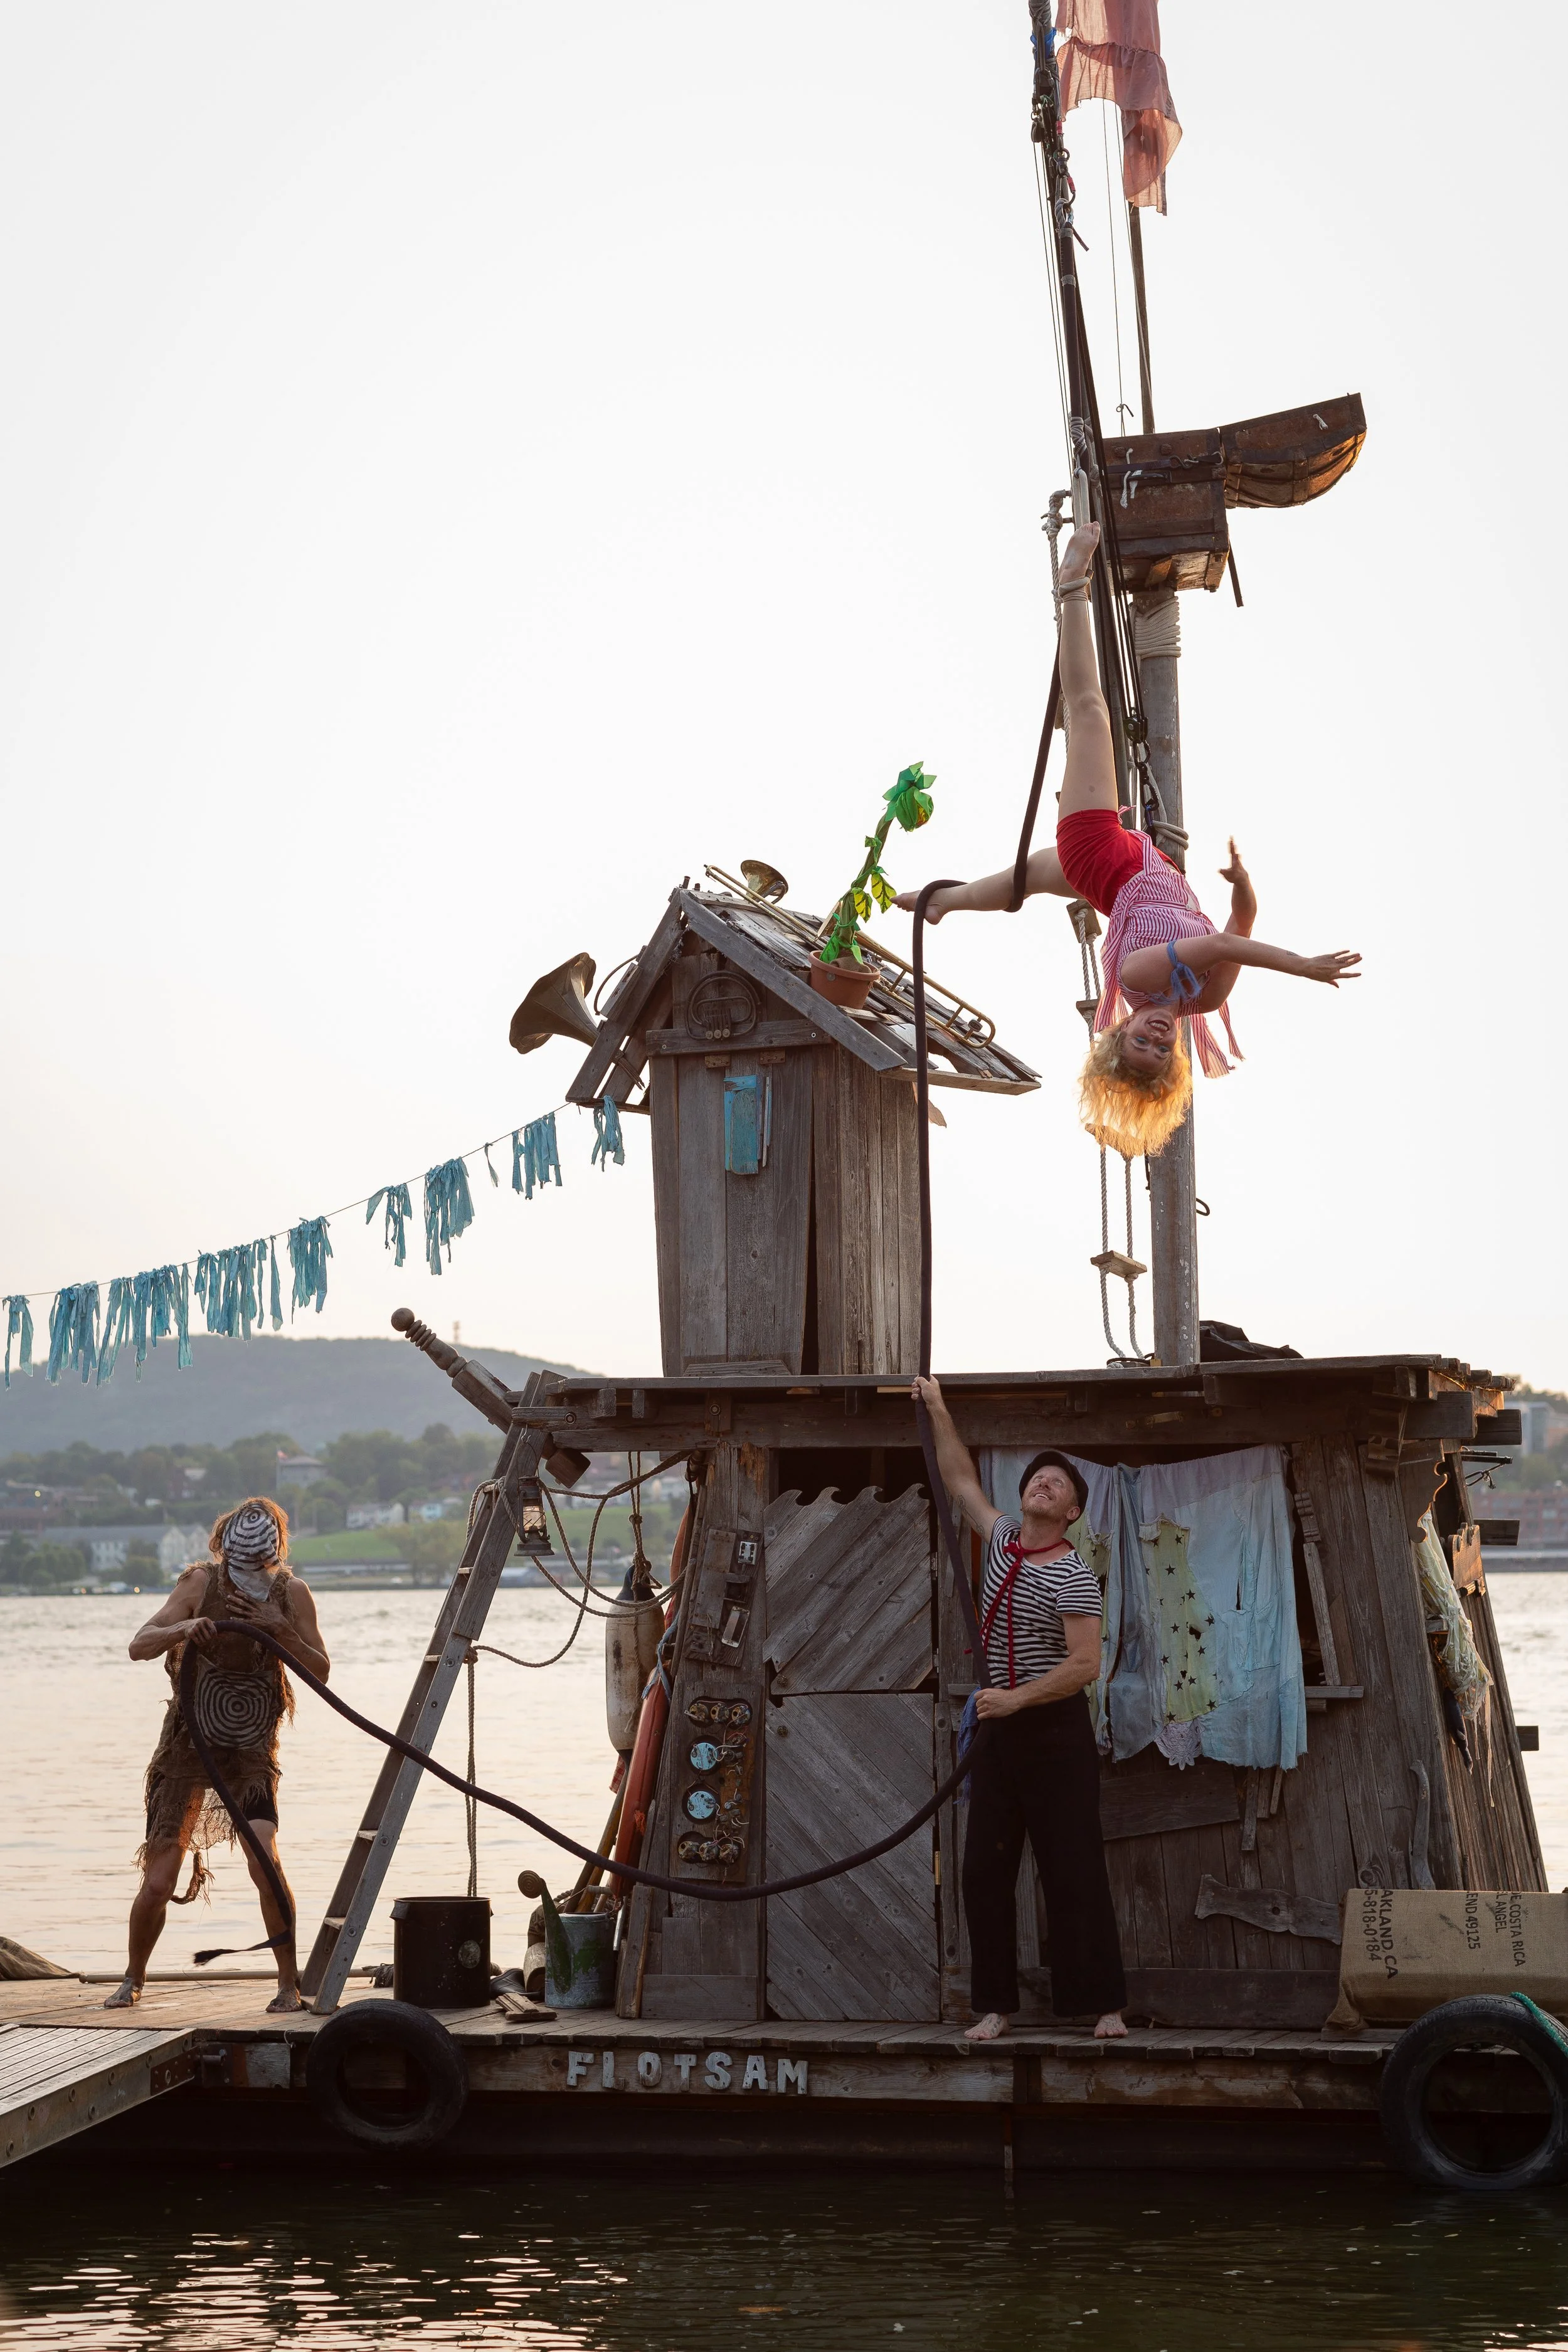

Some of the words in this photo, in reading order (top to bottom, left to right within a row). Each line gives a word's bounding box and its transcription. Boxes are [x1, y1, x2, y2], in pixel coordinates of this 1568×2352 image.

[1466, 1892, 1478, 1914] END
[1495, 1901, 1507, 1933] ANGEL
[1465, 1916, 1480, 1949] 49125
[1509, 1904, 1522, 1938] COSTA
[1384, 1955, 1398, 1979] CA
[1512, 1941, 1526, 1967] RICA
[566, 2051, 808, 2095] FLOTSAM
